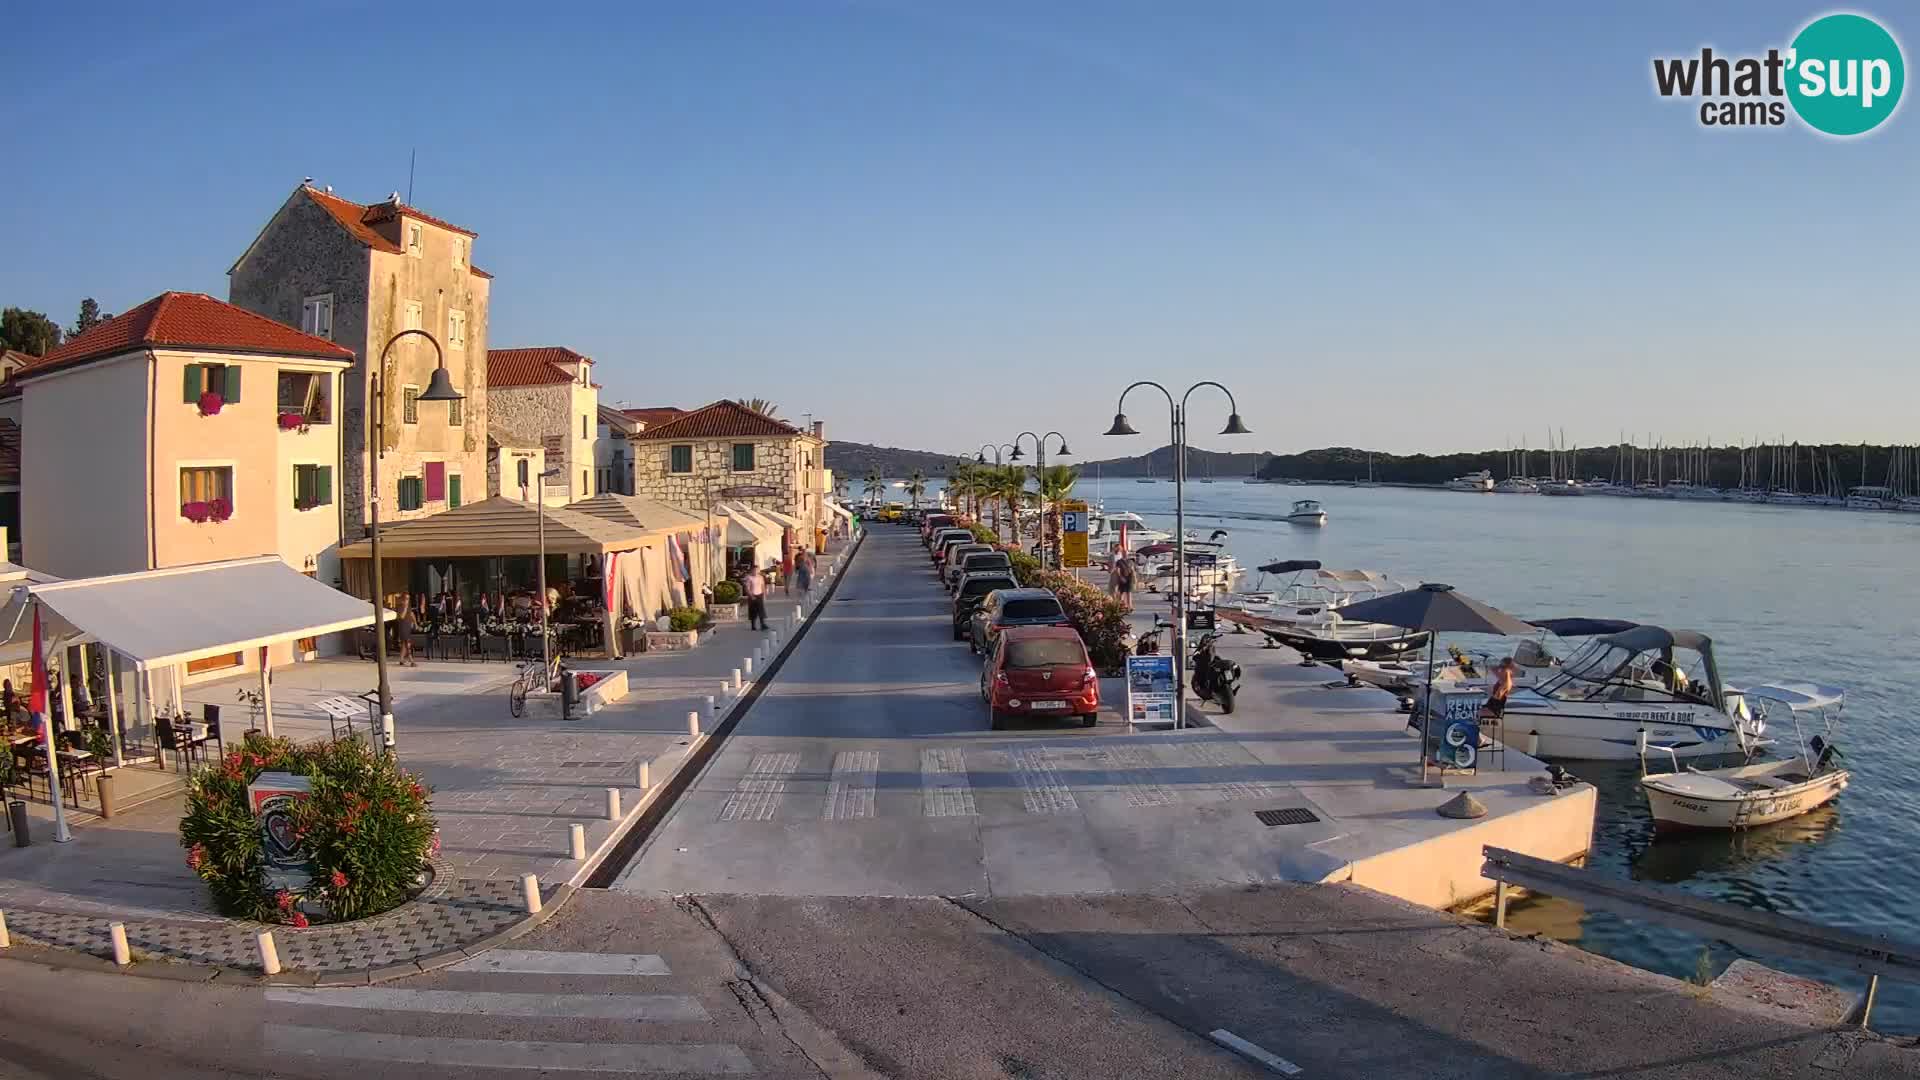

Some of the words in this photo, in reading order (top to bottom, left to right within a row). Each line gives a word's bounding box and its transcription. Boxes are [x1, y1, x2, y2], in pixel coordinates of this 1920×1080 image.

[1064, 514, 1075, 530] P
[1447, 699, 1478, 711] RENT
[1446, 710, 1453, 720] A
[1455, 710, 1478, 720] BOAT
[1650, 711, 1670, 721] RENT
[1677, 711, 1696, 723] BOAT
